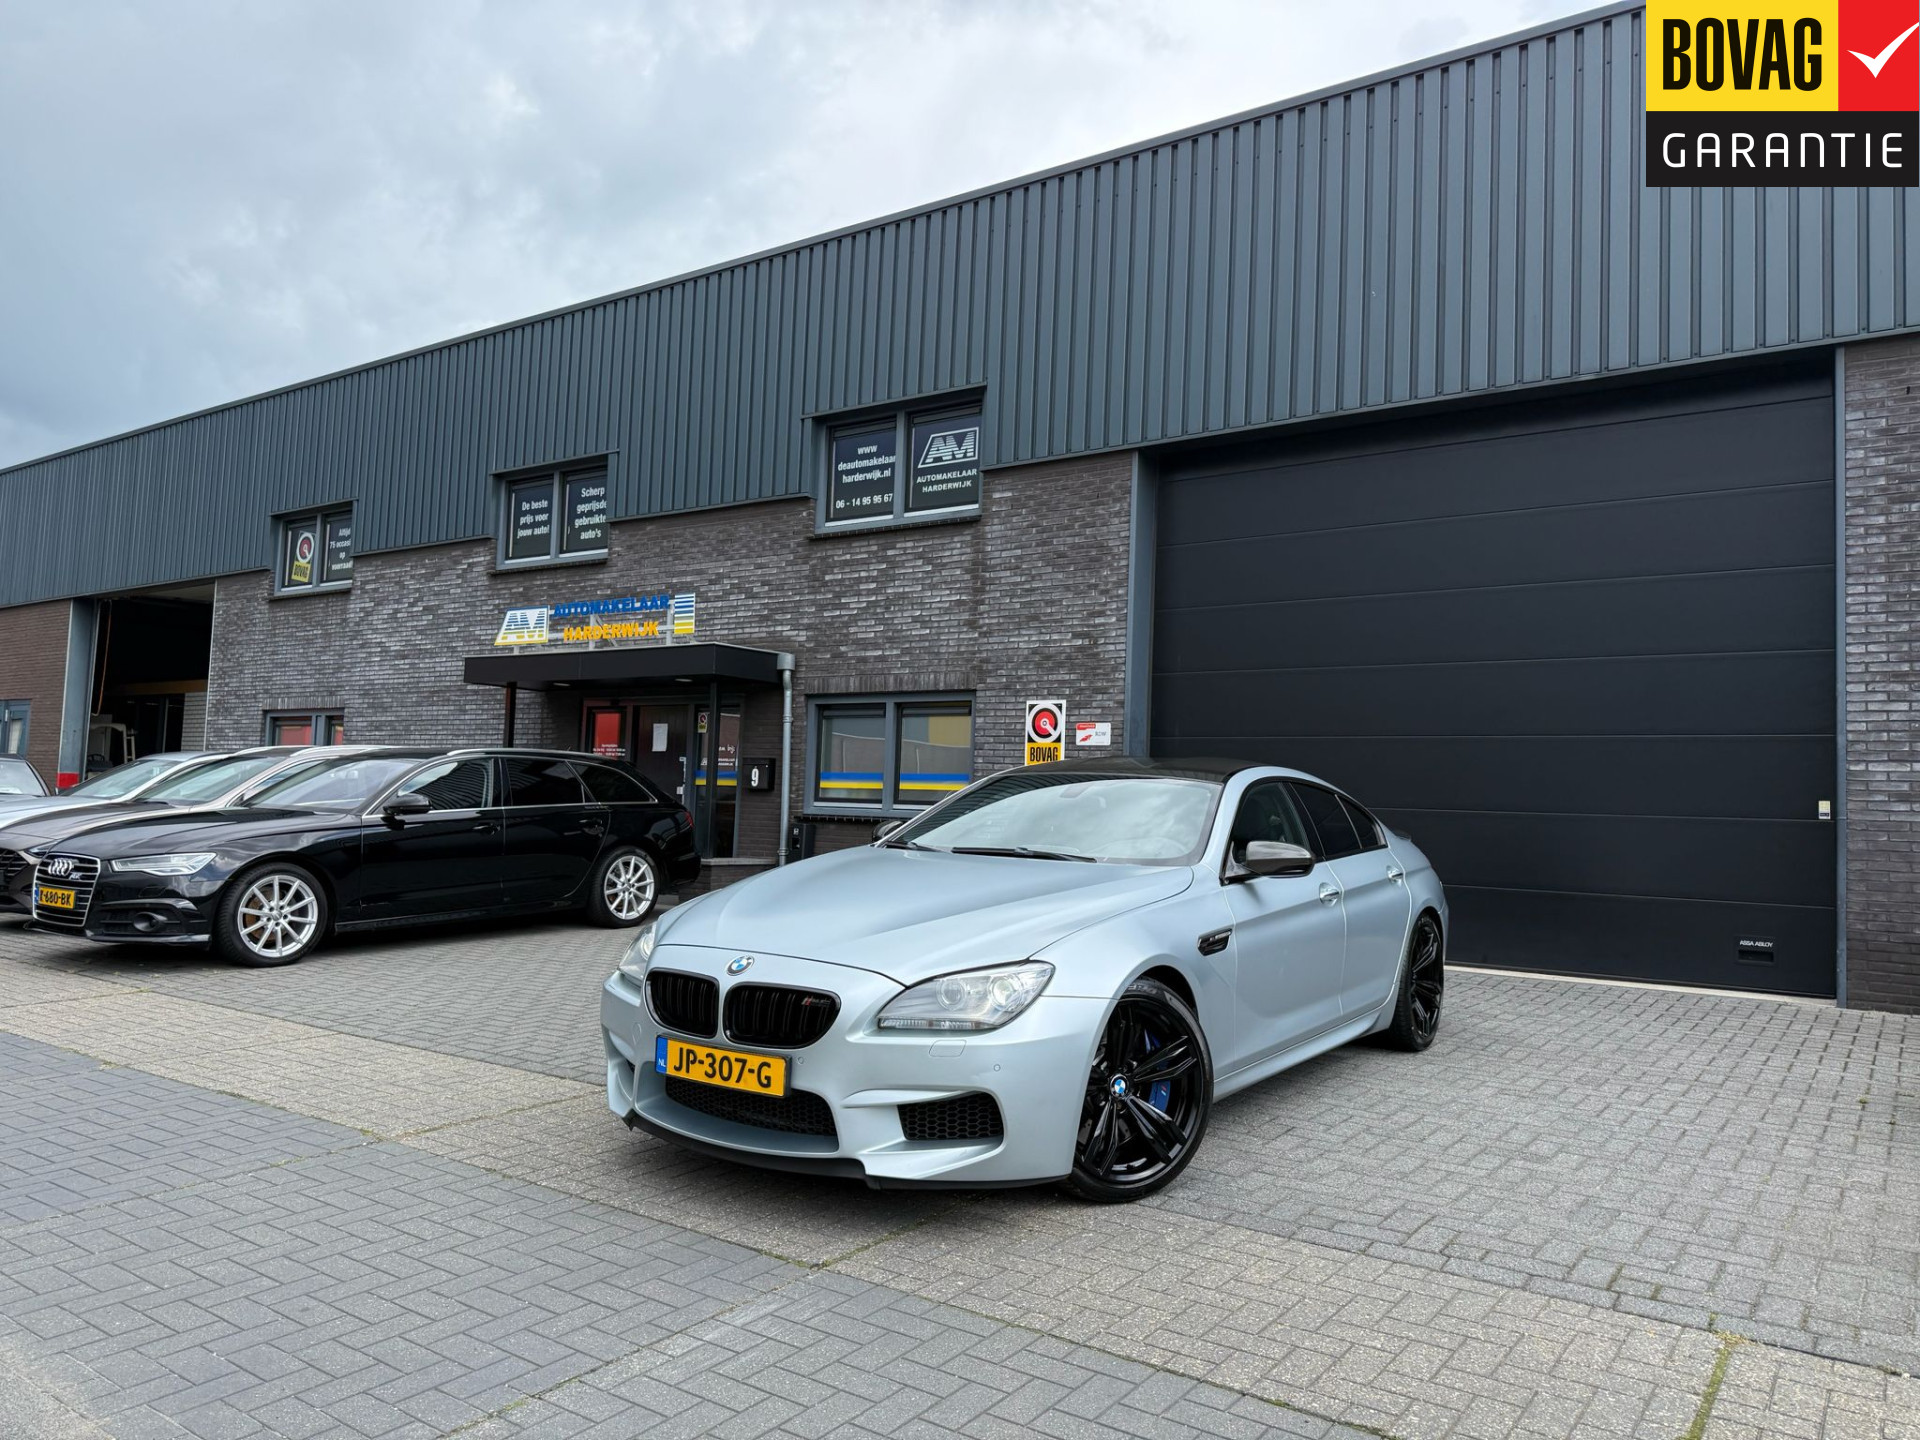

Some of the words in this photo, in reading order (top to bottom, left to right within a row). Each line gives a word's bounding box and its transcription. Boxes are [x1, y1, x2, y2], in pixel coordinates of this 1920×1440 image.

[857, 445, 878, 455] www
[837, 455, 896, 471] deautomakelaar
[842, 467, 892, 484] harderwijk.nl
[916, 468, 978, 484] AUTOMAKELAAR
[581, 486, 606, 498] Scherp
[922, 479, 972, 493] HARDERWIJK
[521, 501, 530, 511] De
[531, 498, 549, 510] beste
[835, 499, 845, 509] 06
[852, 497, 861, 507] 14
[862, 496, 872, 506] 95
[872, 494, 882, 504] 95
[883, 493, 893, 503] 67
[519, 513, 534, 526] prijs
[535, 512, 549, 522] voor
[516, 527, 533, 539] jouw
[580, 528, 602, 540] auto's
[553, 594, 670, 617] AUTOMAKELAAR
[563, 621, 659, 642] HARDERWIJK
[1029, 746, 1059, 762] BOVAG
[751, 767, 760, 787] 9
[658, 1057, 667, 1068] NL
[673, 1046, 772, 1089] JP-307-G
